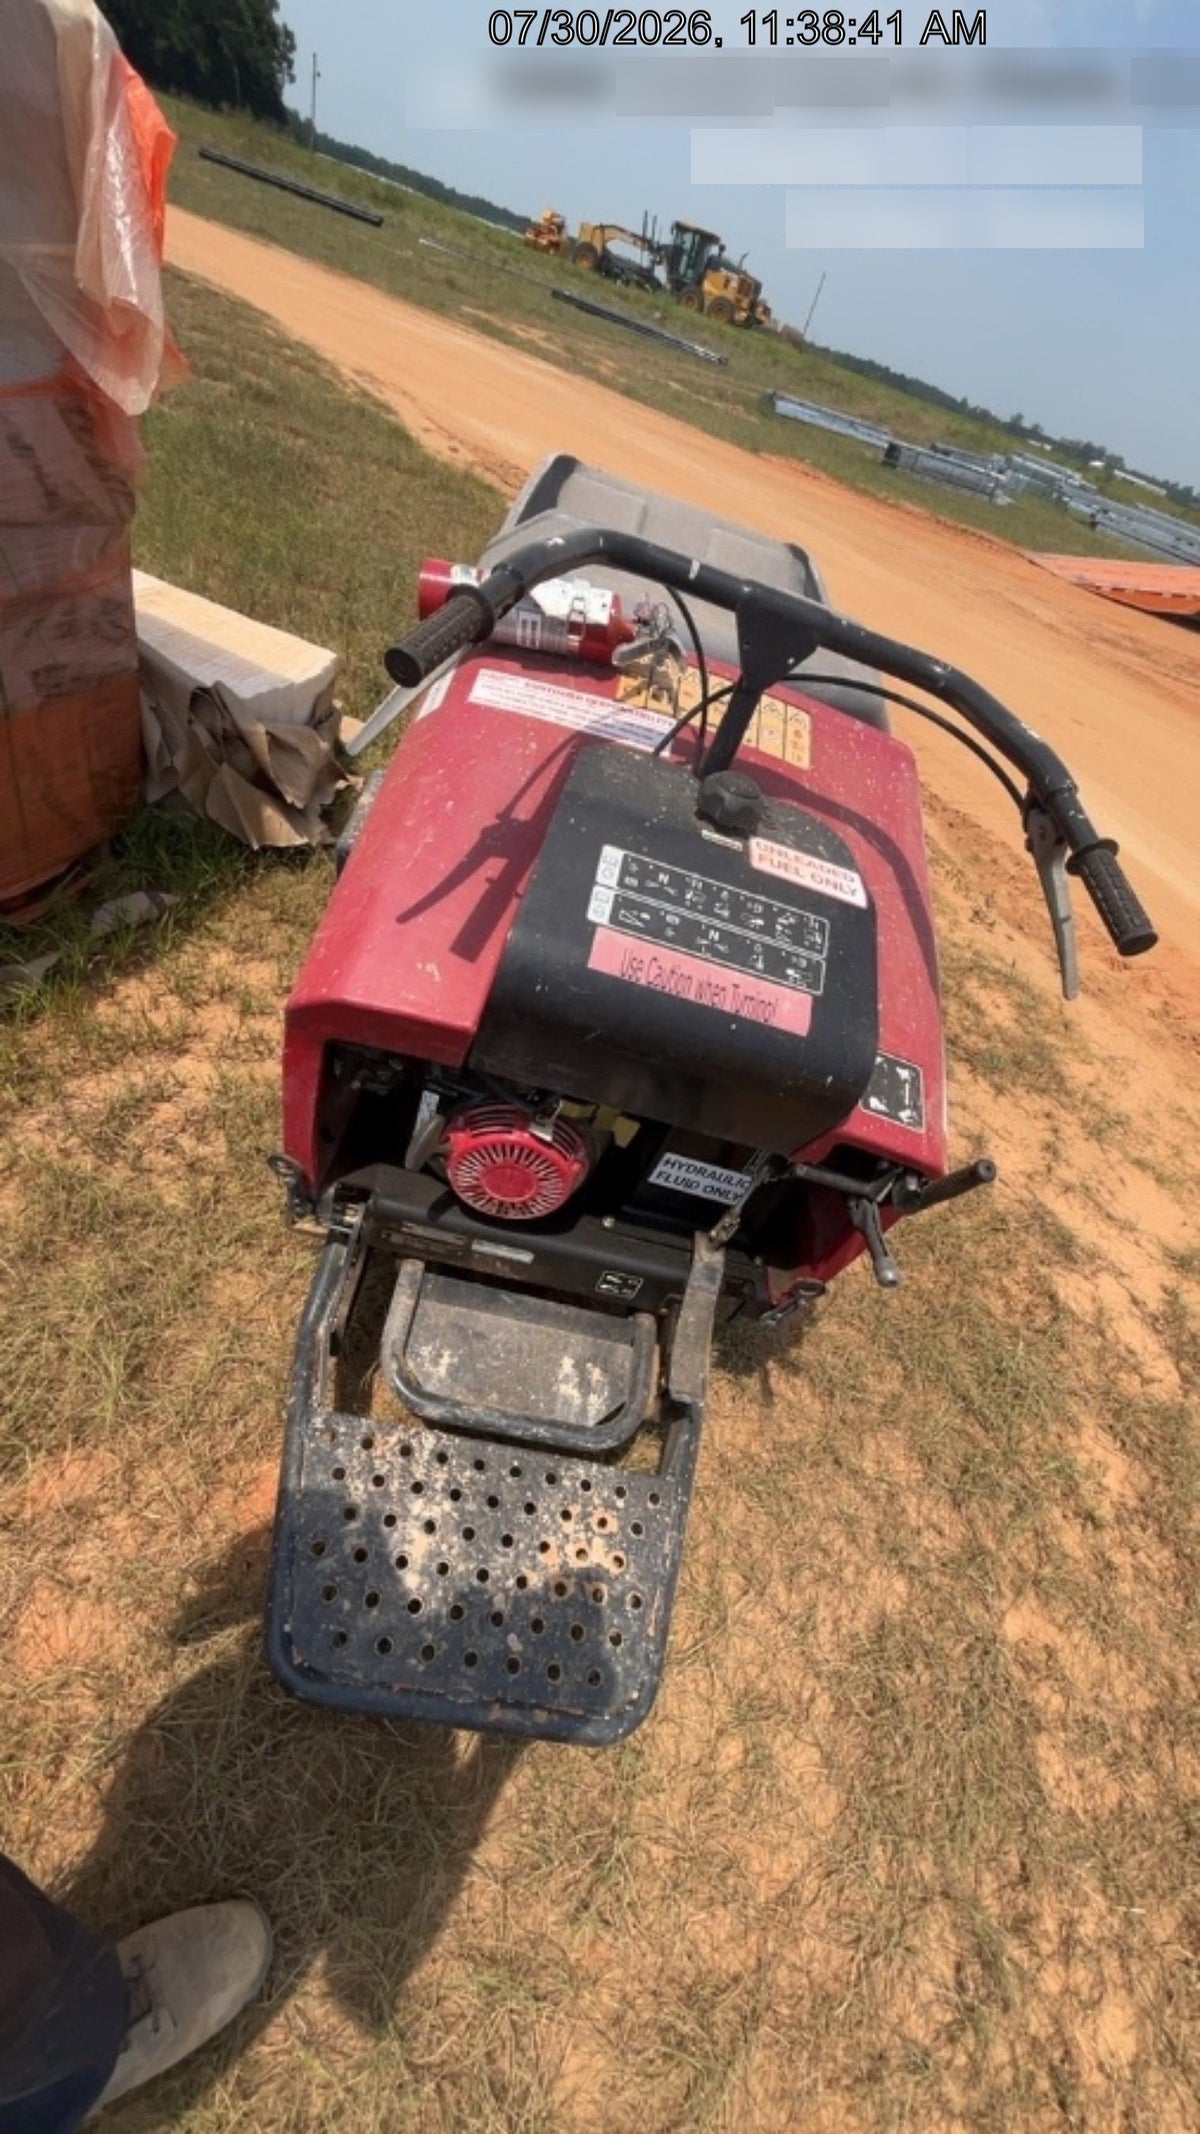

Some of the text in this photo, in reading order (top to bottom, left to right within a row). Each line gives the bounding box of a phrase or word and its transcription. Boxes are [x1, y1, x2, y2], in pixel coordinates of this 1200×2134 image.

[755, 840, 856, 883] UNLEADED
[757, 853, 858, 898] FUEL ONLY
[620, 946, 779, 1025] Use Caution when Turning!
[655, 1170, 744, 1202] FLUID ONLY
